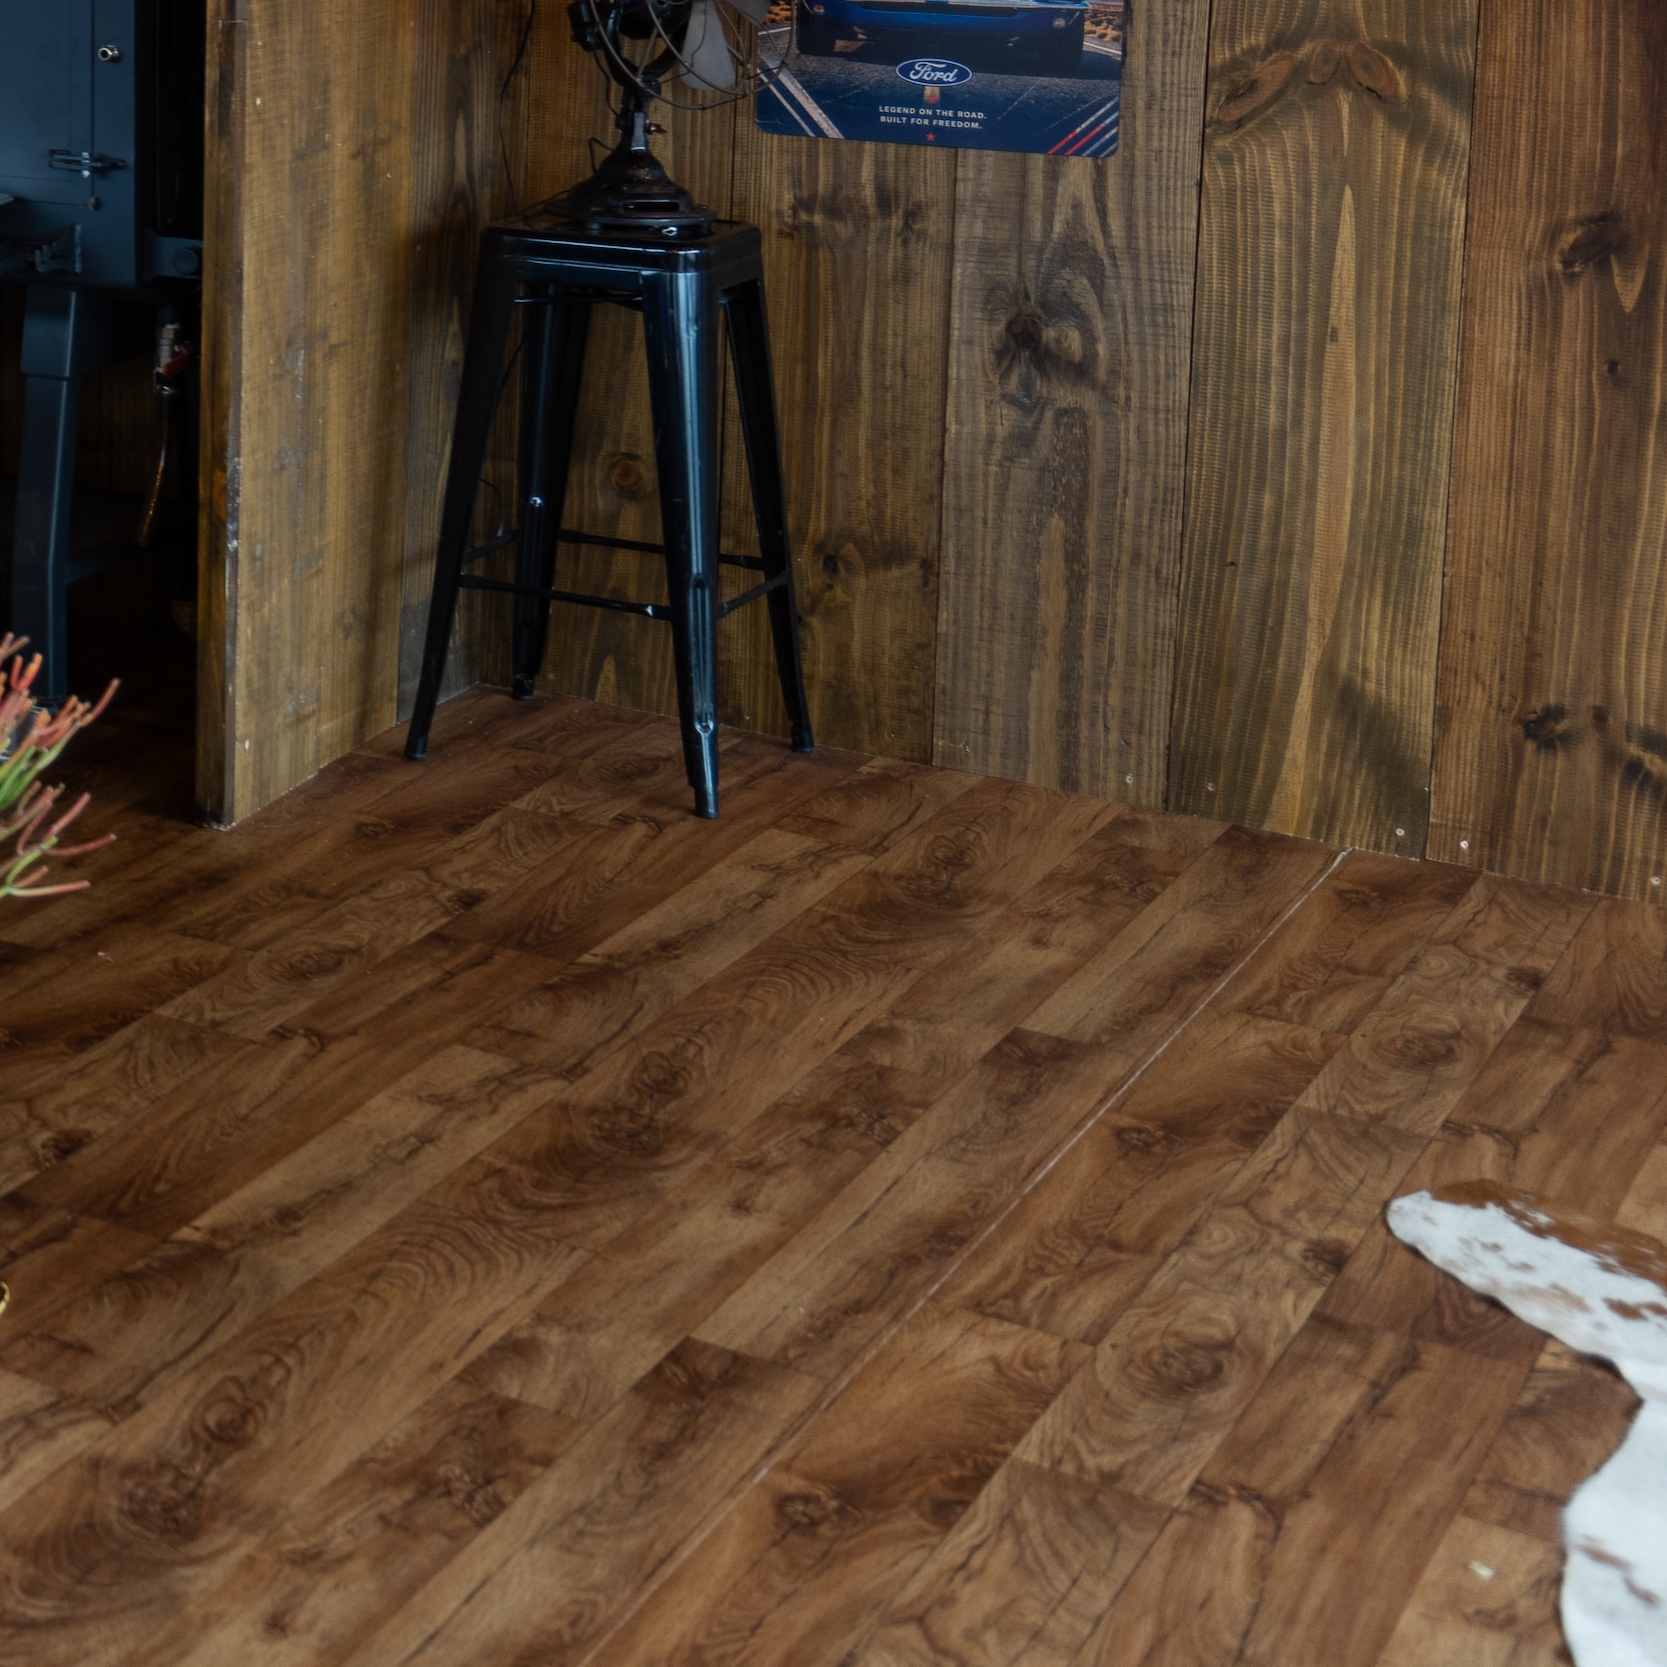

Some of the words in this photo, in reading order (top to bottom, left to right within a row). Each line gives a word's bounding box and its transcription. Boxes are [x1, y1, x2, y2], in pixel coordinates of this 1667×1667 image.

[909, 61, 958, 82] Ford
[879, 105, 916, 115] LEGEND
[936, 109, 954, 117] THE
[957, 110, 987, 119] ROAD.
[933, 119, 982, 129] FREEDOM.
